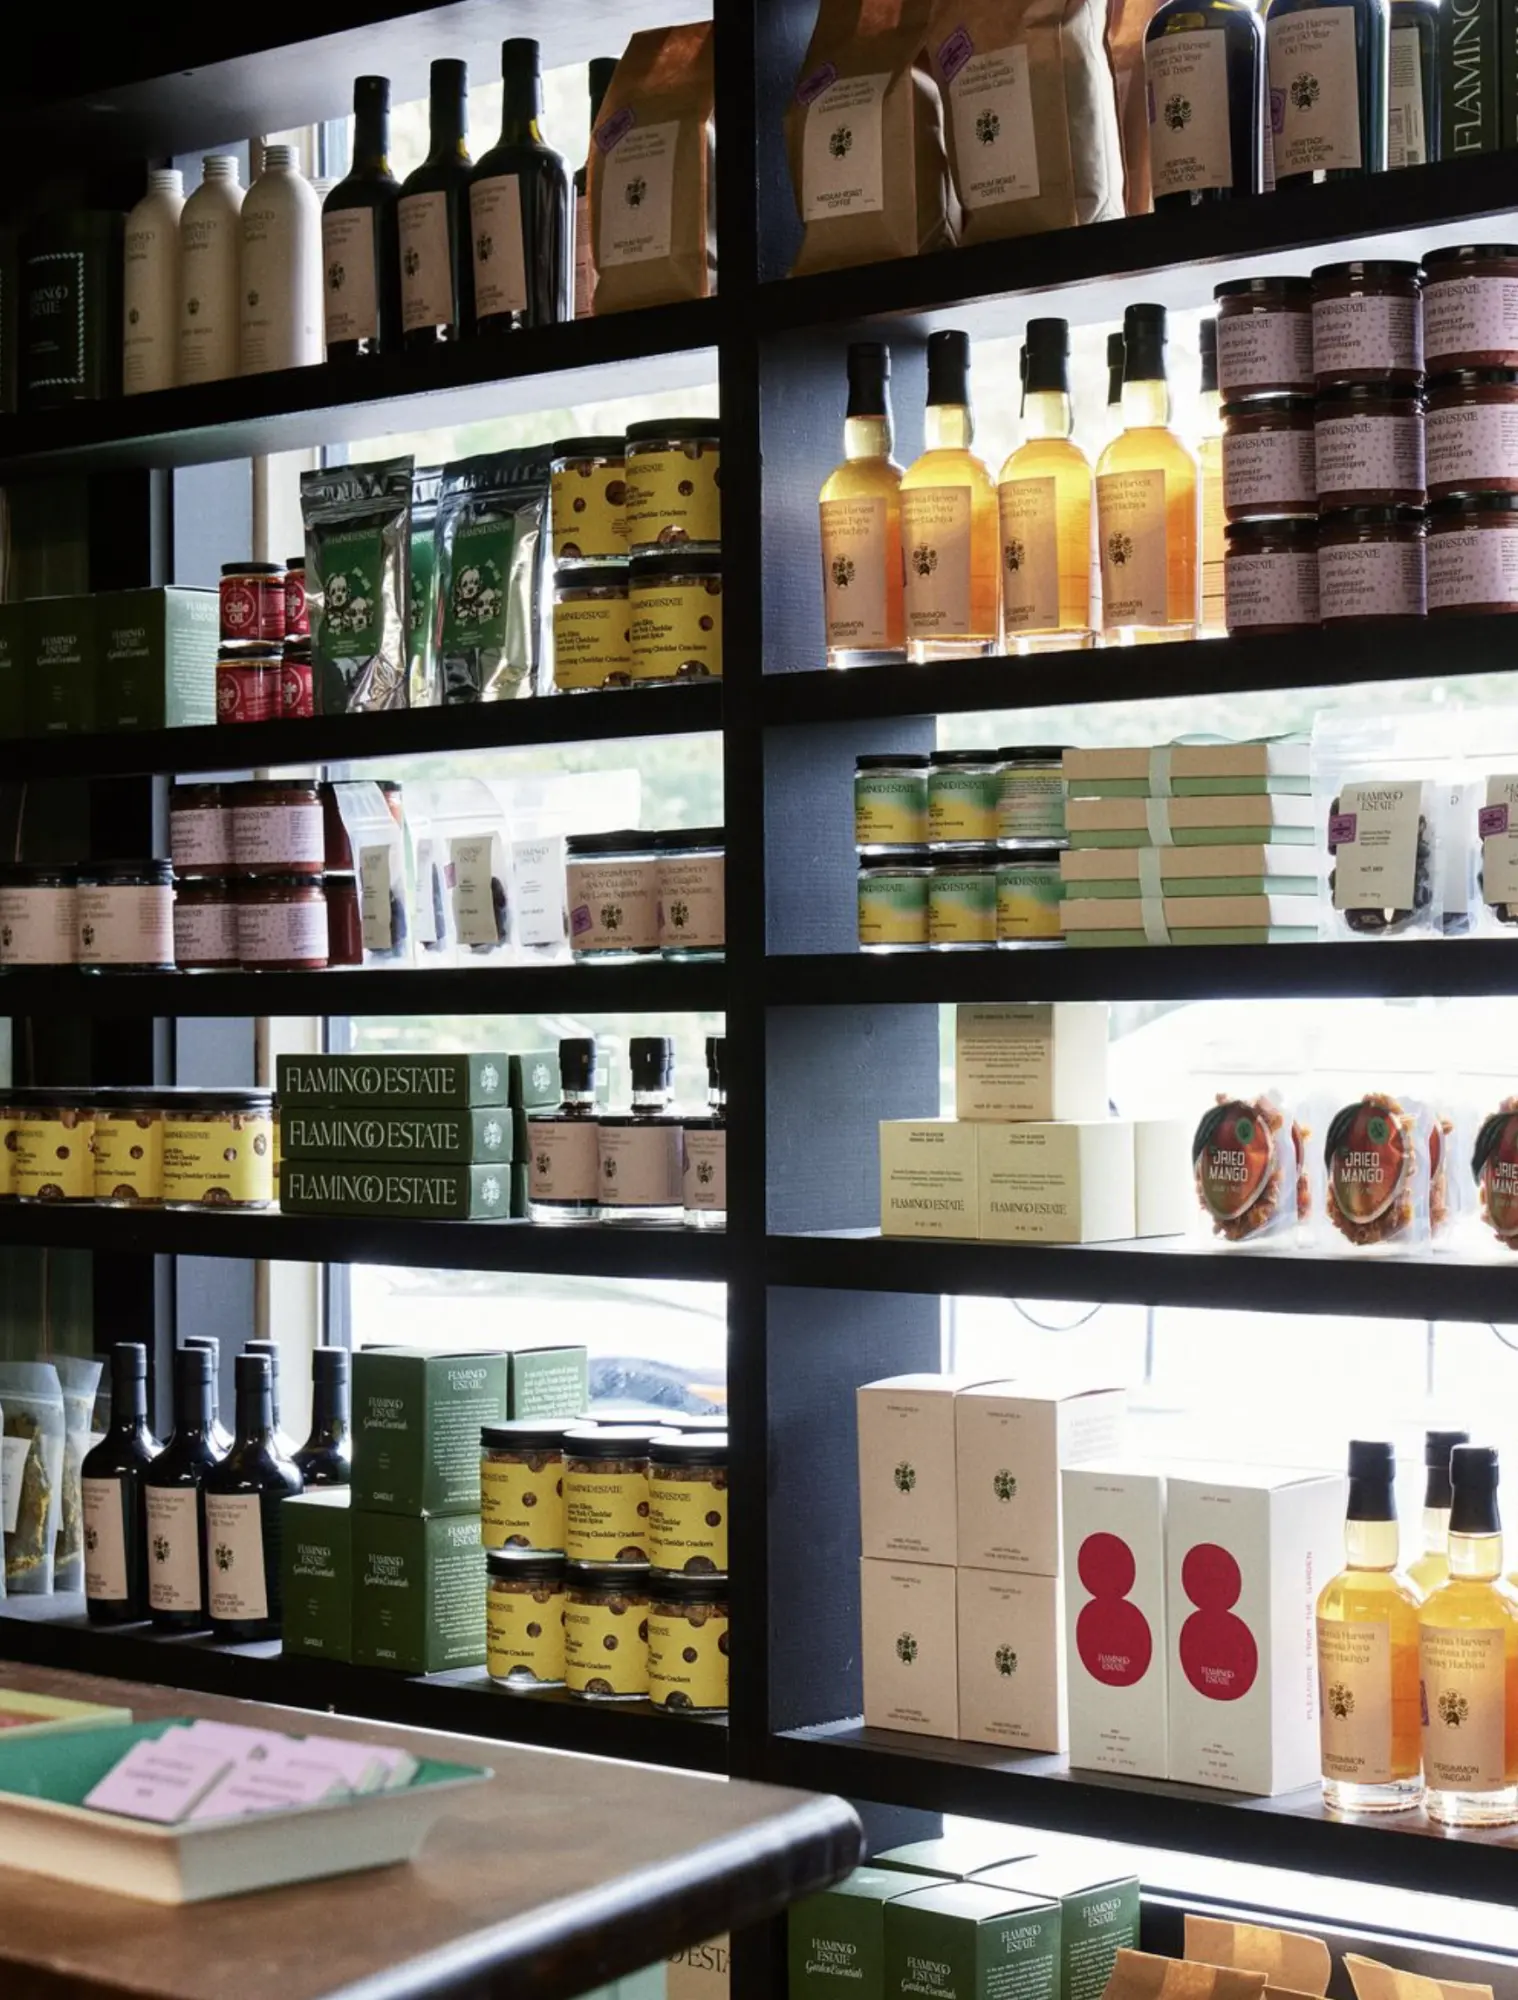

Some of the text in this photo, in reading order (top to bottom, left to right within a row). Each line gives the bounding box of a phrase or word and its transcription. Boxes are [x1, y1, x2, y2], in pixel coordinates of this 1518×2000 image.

[1357, 790, 1404, 801] FLAMINGO
[1361, 800, 1394, 811] ESTATE
[285, 1065, 457, 1095] FLAMINGO ESTATE
[289, 1119, 460, 1149] FLAMINGO ESTATE
[1213, 1150, 1245, 1166] DRIED
[1345, 1151, 1380, 1167] DRIED
[1209, 1166, 1248, 1182] MANGO
[1341, 1168, 1384, 1184] MANGO
[1495, 1161, 1518, 1179] DRIE
[288, 1172, 458, 1206] FLAMINGO ESTATE
[890, 1196, 965, 1212] FLAMINGO ESTATE
[990, 1201, 1068, 1215] FLAMINGO ESTATE
[1454, 1637, 1492, 1648] Harvest
[1434, 1762, 1479, 1775] PERSIMMON
[1440, 1773, 1472, 1783] VINEGAR
[1082, 1896, 1122, 1918] FLAMINGO
[1088, 1910, 1117, 1928] ESTATE
[1000, 1924, 1042, 1943] FLAMINGO
[811, 1937, 857, 1955] FLAMINGO
[1005, 1937, 1037, 1954] ESTATE
[816, 1950, 851, 1966] ESTATE
[906, 1955, 951, 1976] FLAMINGO
[911, 1969, 945, 1986] ESTATE
